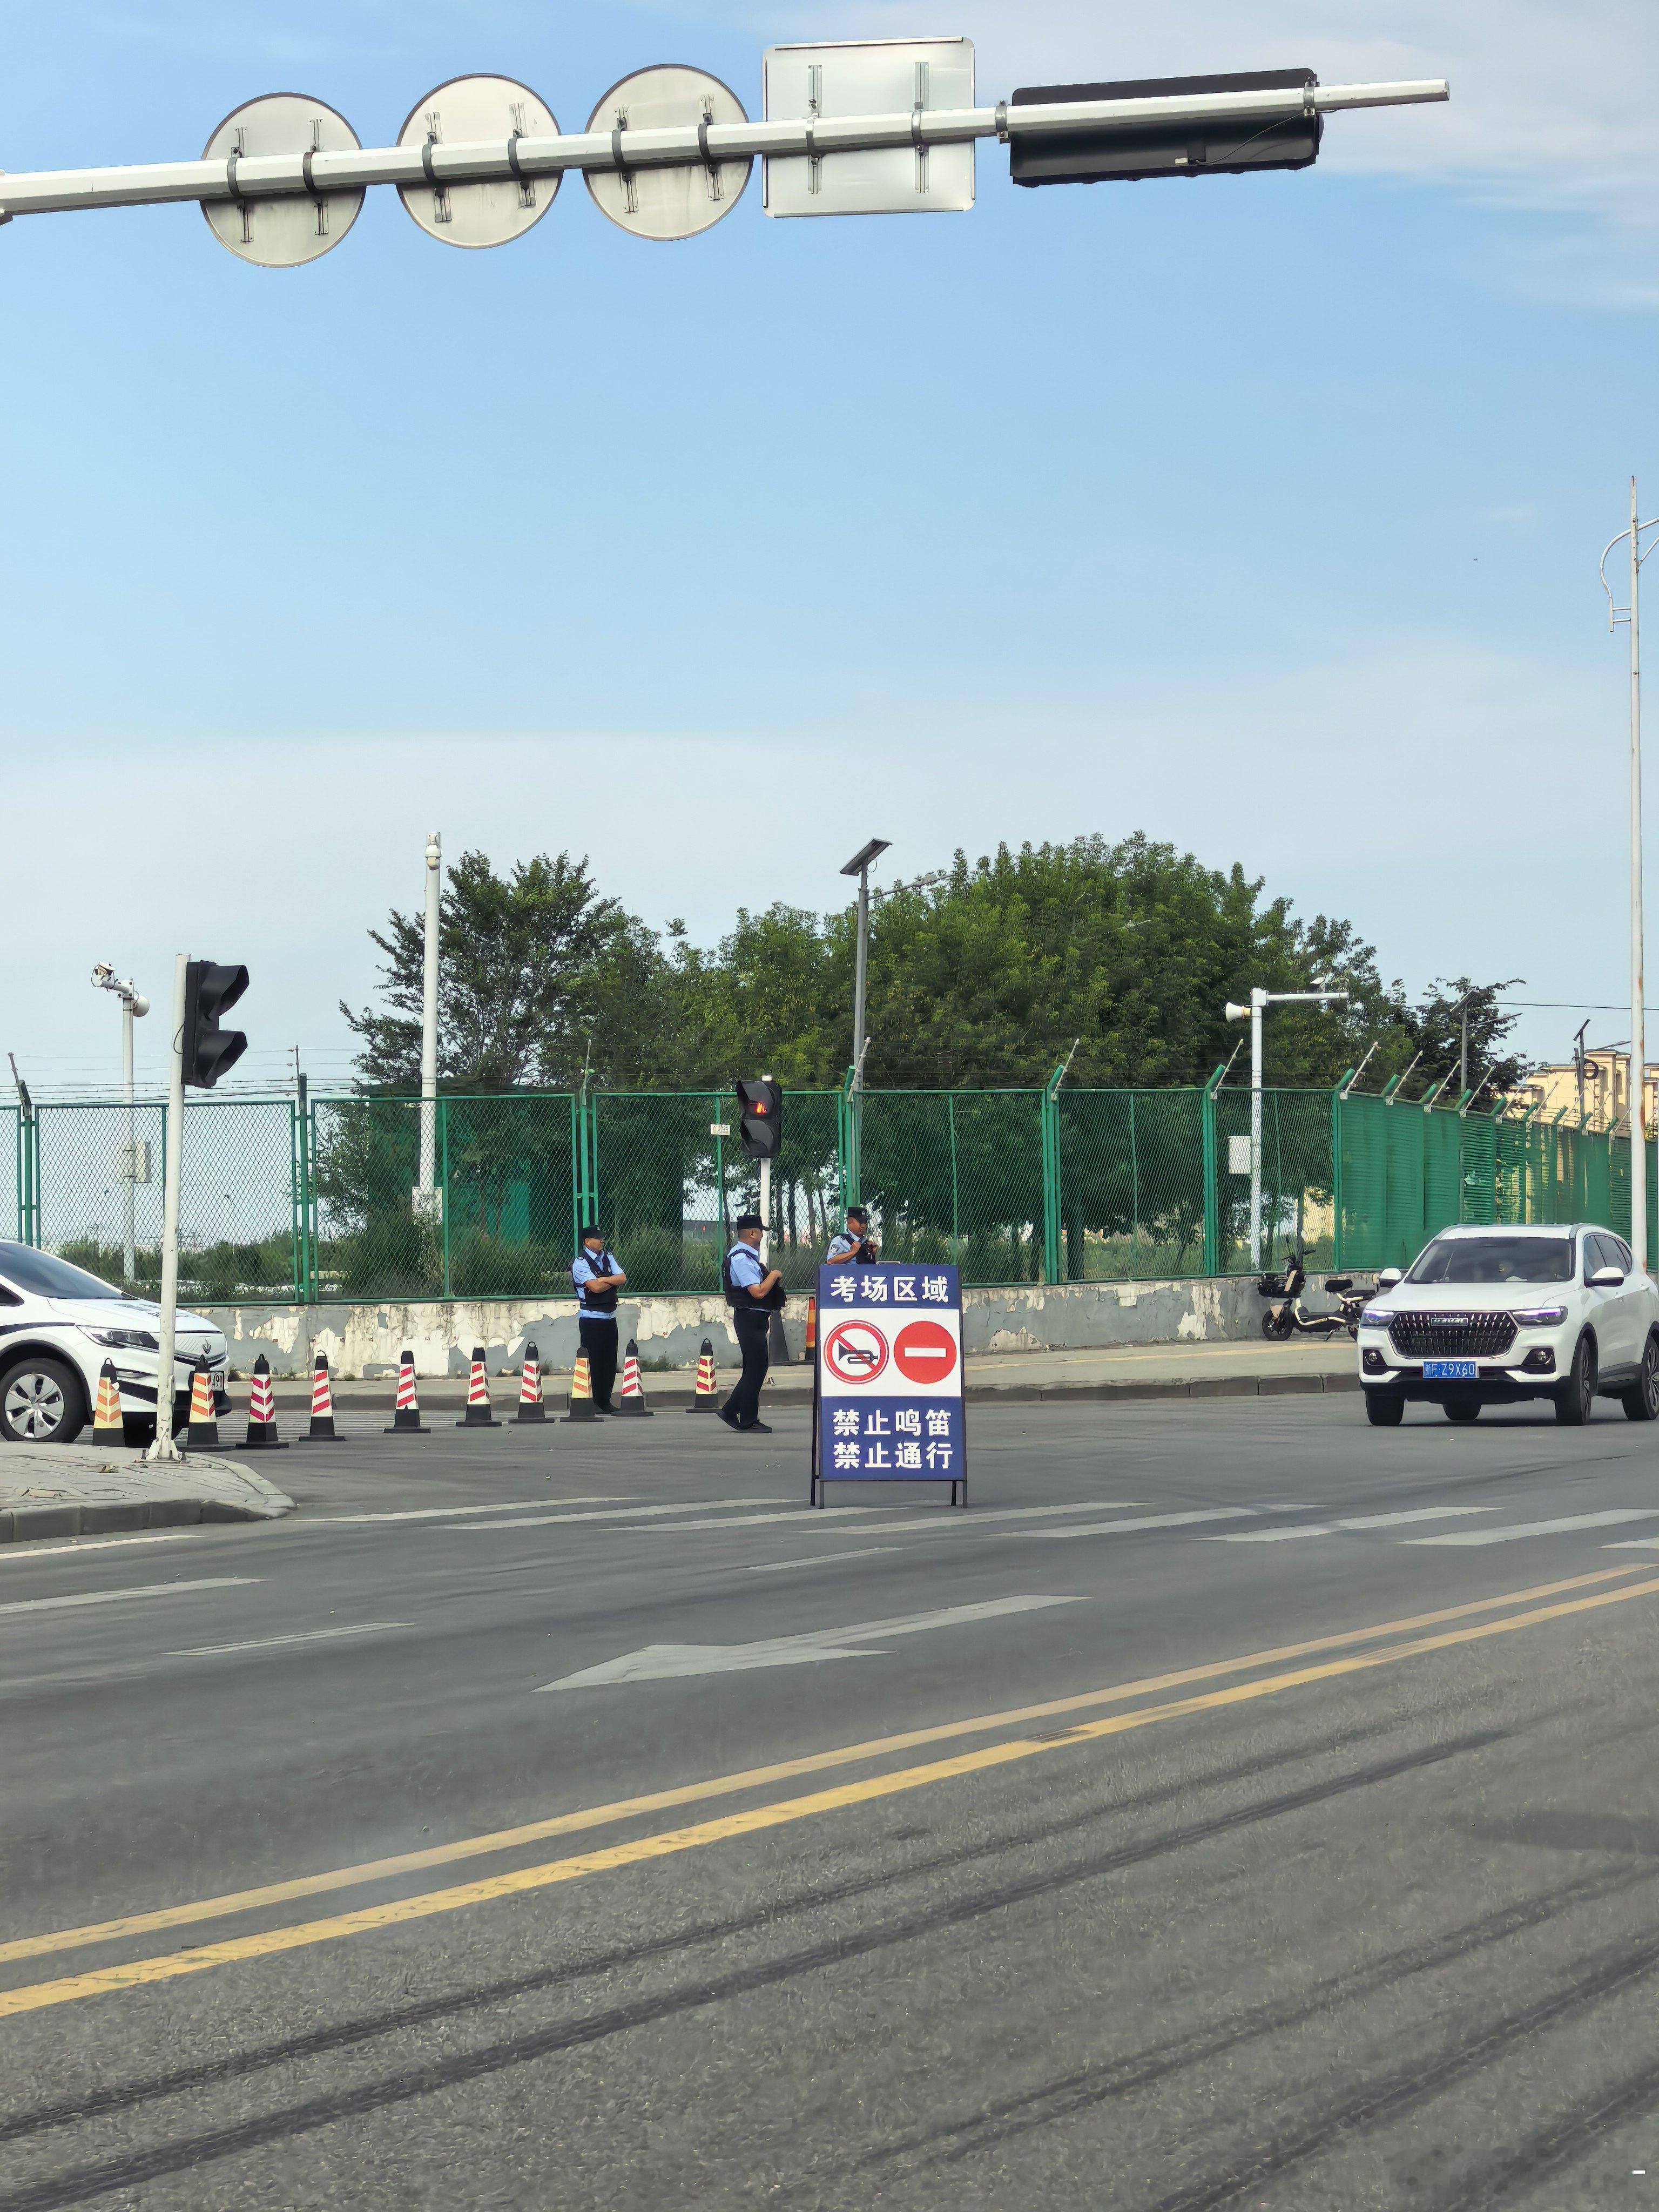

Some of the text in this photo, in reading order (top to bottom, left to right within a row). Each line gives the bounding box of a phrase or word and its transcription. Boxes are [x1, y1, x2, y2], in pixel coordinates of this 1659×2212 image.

[830, 1275, 949, 1303] 考场区域
[832, 1408, 952, 1437] 禁止鸣笛
[833, 1441, 954, 1469] 禁止通行
